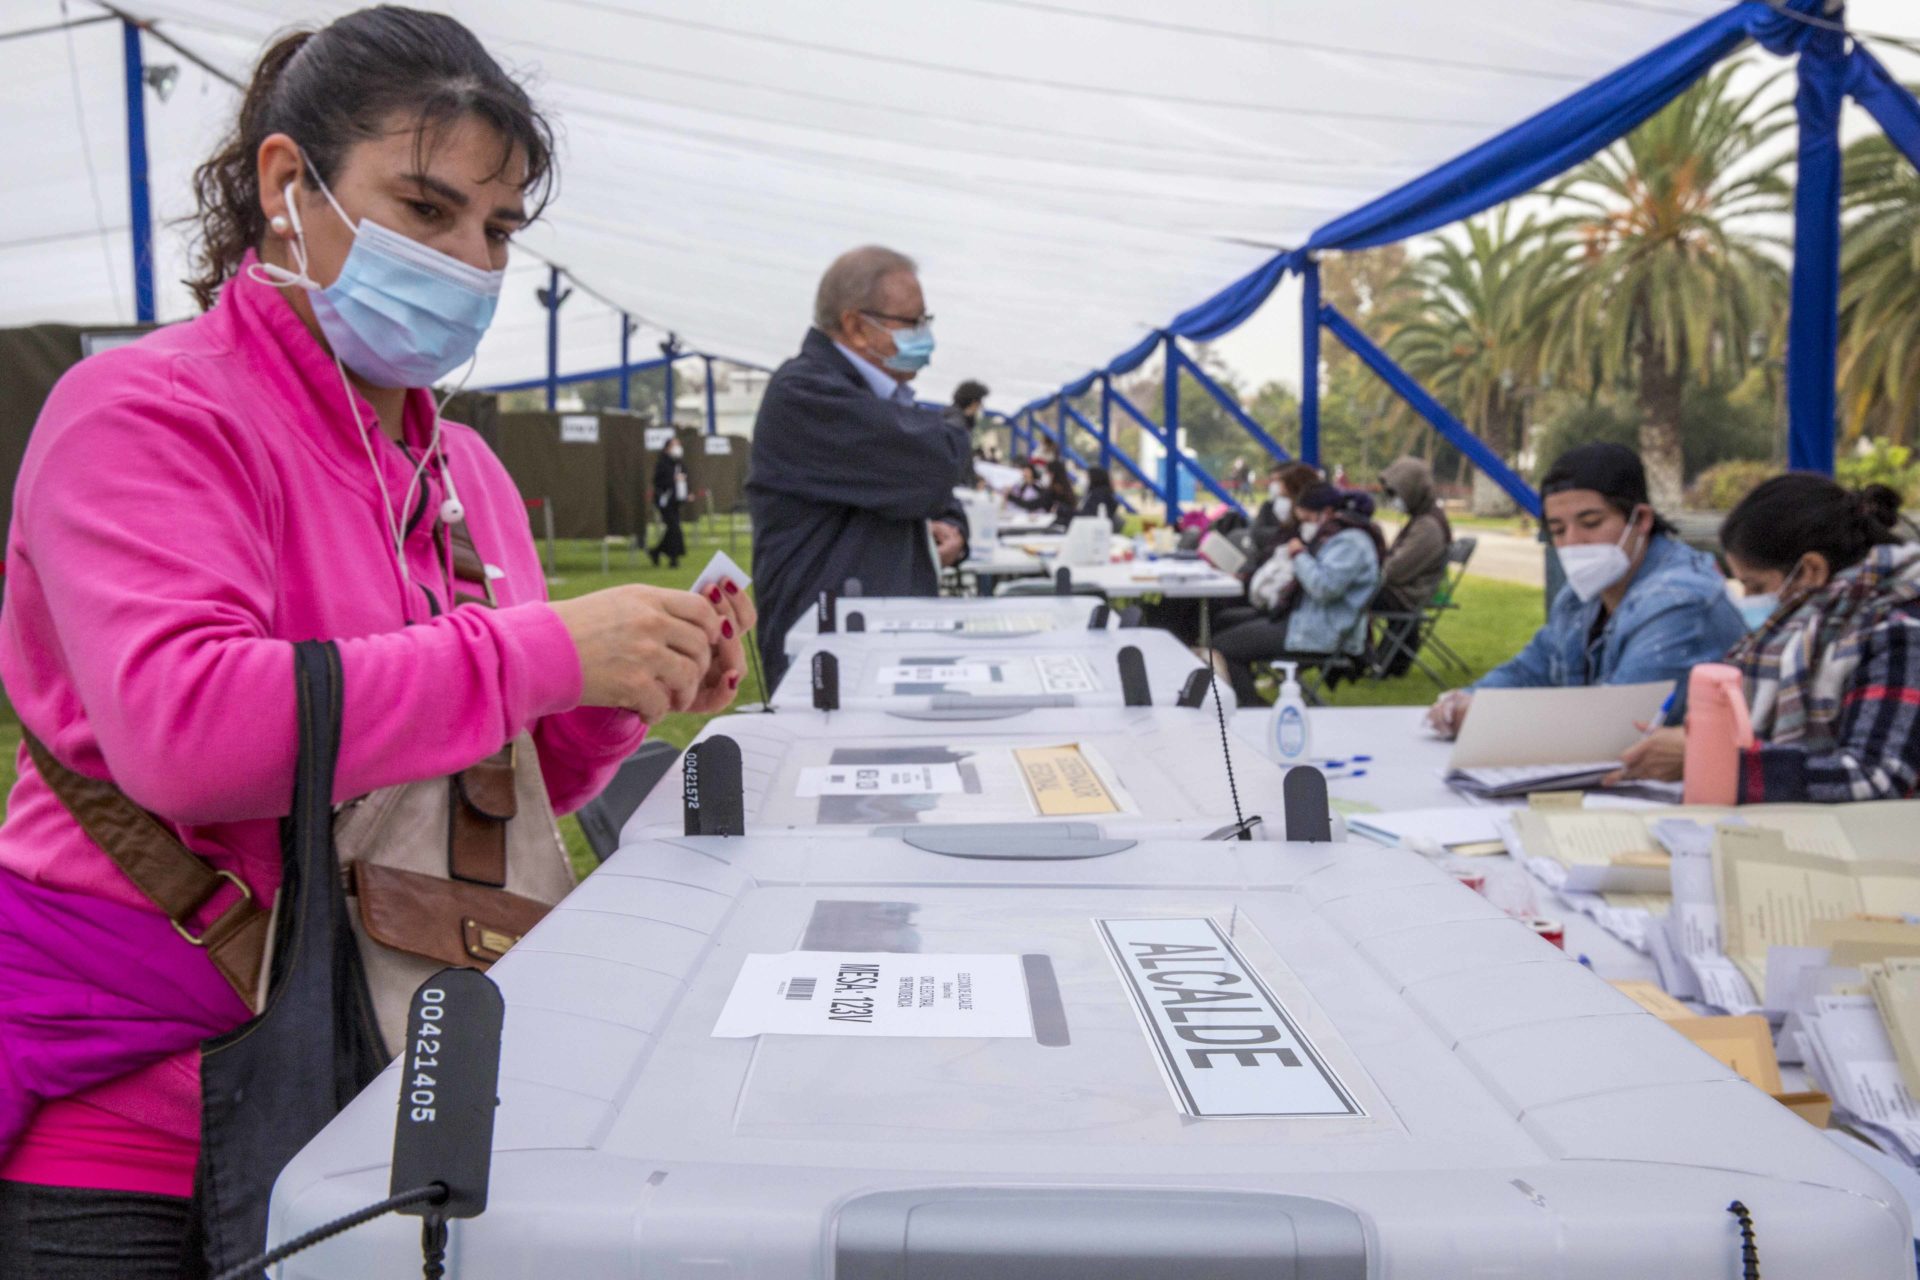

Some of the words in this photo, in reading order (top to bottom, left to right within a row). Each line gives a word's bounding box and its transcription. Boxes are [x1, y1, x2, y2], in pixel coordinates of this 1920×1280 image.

[686, 753, 700, 809] 00421572
[834, 963, 880, 994] MESA:
[828, 996, 874, 1023] 123V
[919, 986, 934, 1008] ELECTORAL
[958, 993, 973, 1010] ALCALDE
[1128, 942, 1303, 1069] ALCALDE
[411, 988, 445, 1123] 00421405
